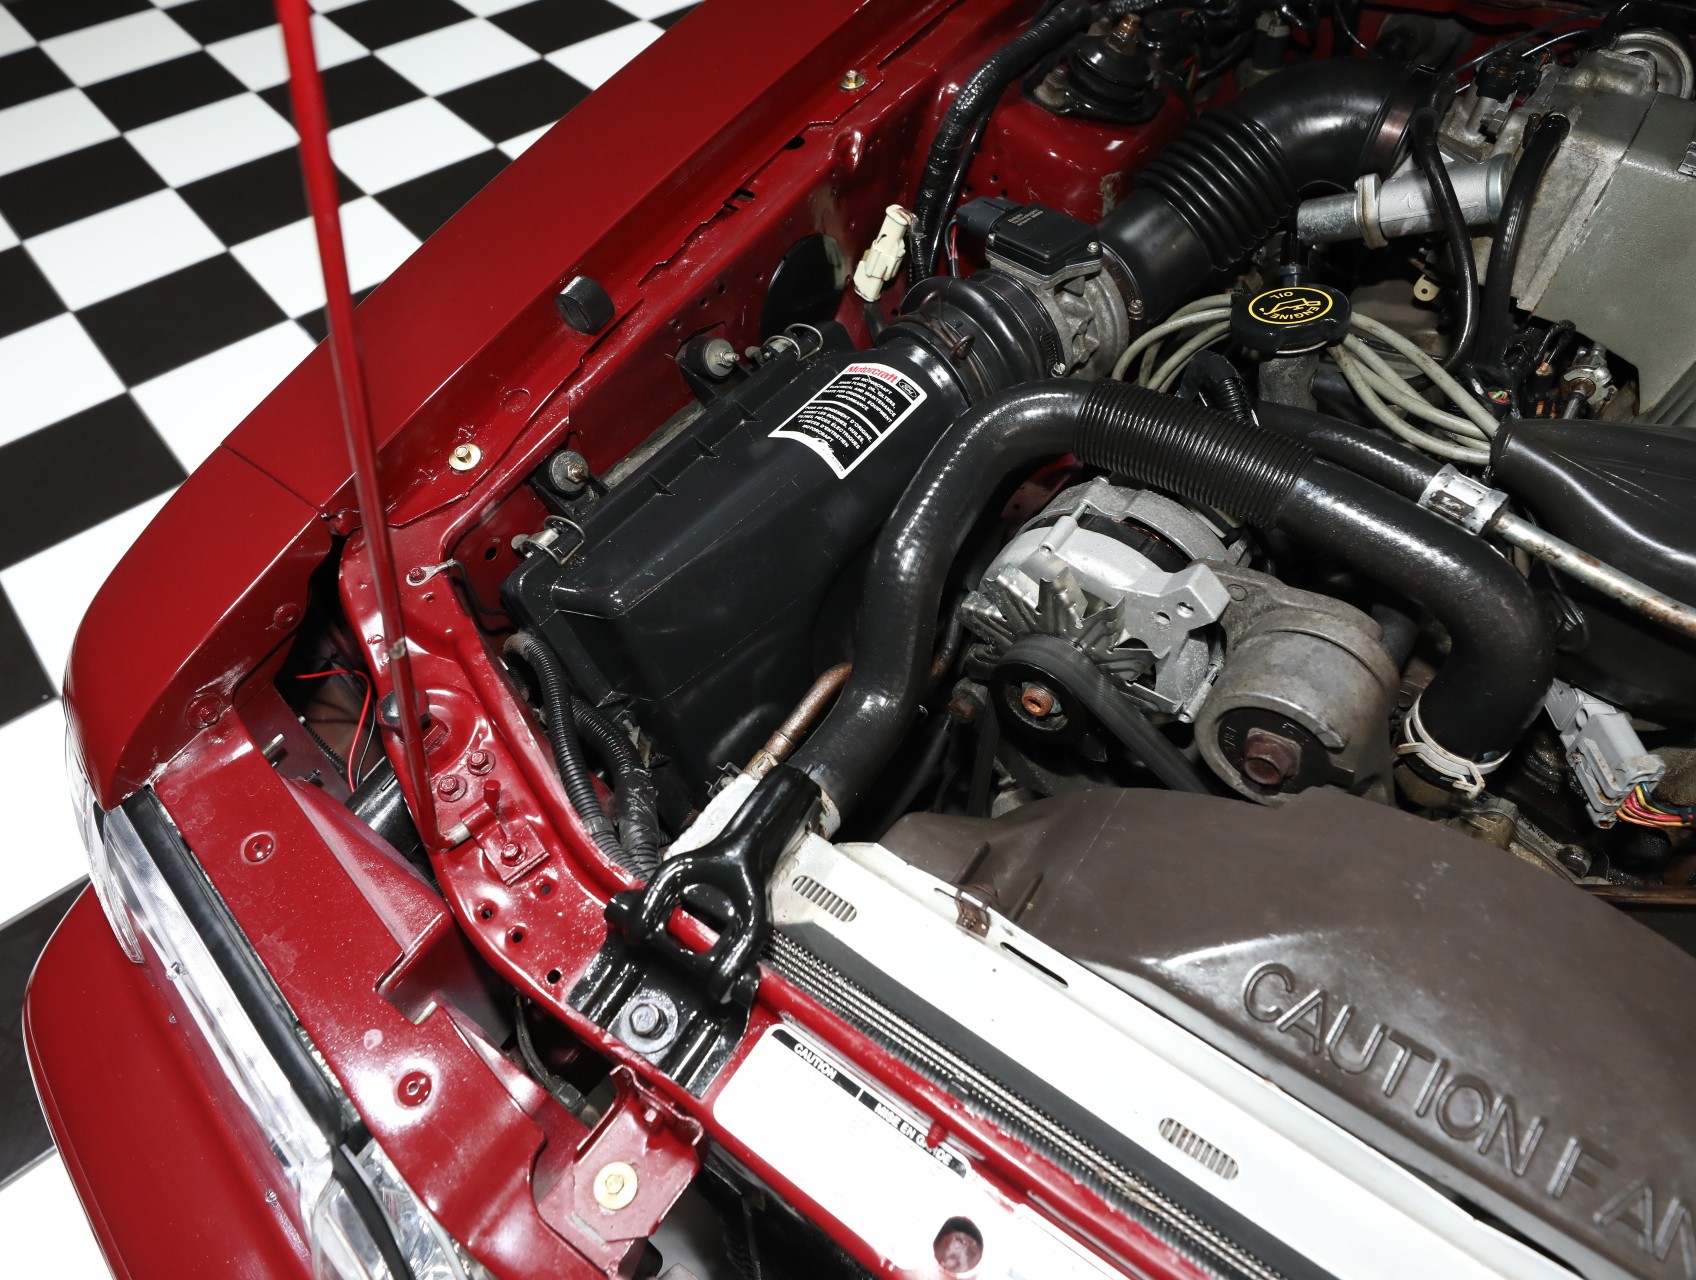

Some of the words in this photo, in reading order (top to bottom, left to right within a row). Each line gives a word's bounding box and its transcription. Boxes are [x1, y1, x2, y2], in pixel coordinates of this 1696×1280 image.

[1269, 291, 1294, 299] OIL
[1269, 306, 1320, 320] ENGINE
[846, 366, 898, 383] Motorcraft
[861, 377, 893, 395] MOTORCRAFT
[835, 394, 870, 411] PERFORMANCE
[845, 390, 867, 402] ORIGINAL
[866, 400, 893, 423] EQUIPMENT
[864, 391, 897, 418] MAINTENANCE
[877, 390, 896, 409] FILTERS,
[802, 424, 835, 442] MOTORCRAFT
[823, 406, 851, 420] RENDEMENT
[850, 418, 873, 443] D'ORIGINE,
[819, 423, 850, 448] D'ENTRETIEN
[847, 426, 865, 445] HUILES,
[794, 1043, 838, 1081] CAUTION
[874, 1102, 901, 1129] MISE
[900, 1122, 917, 1140] EN
[1242, 960, 1548, 1177] CAUTION
[1545, 1135, 1696, 1280] FAN
